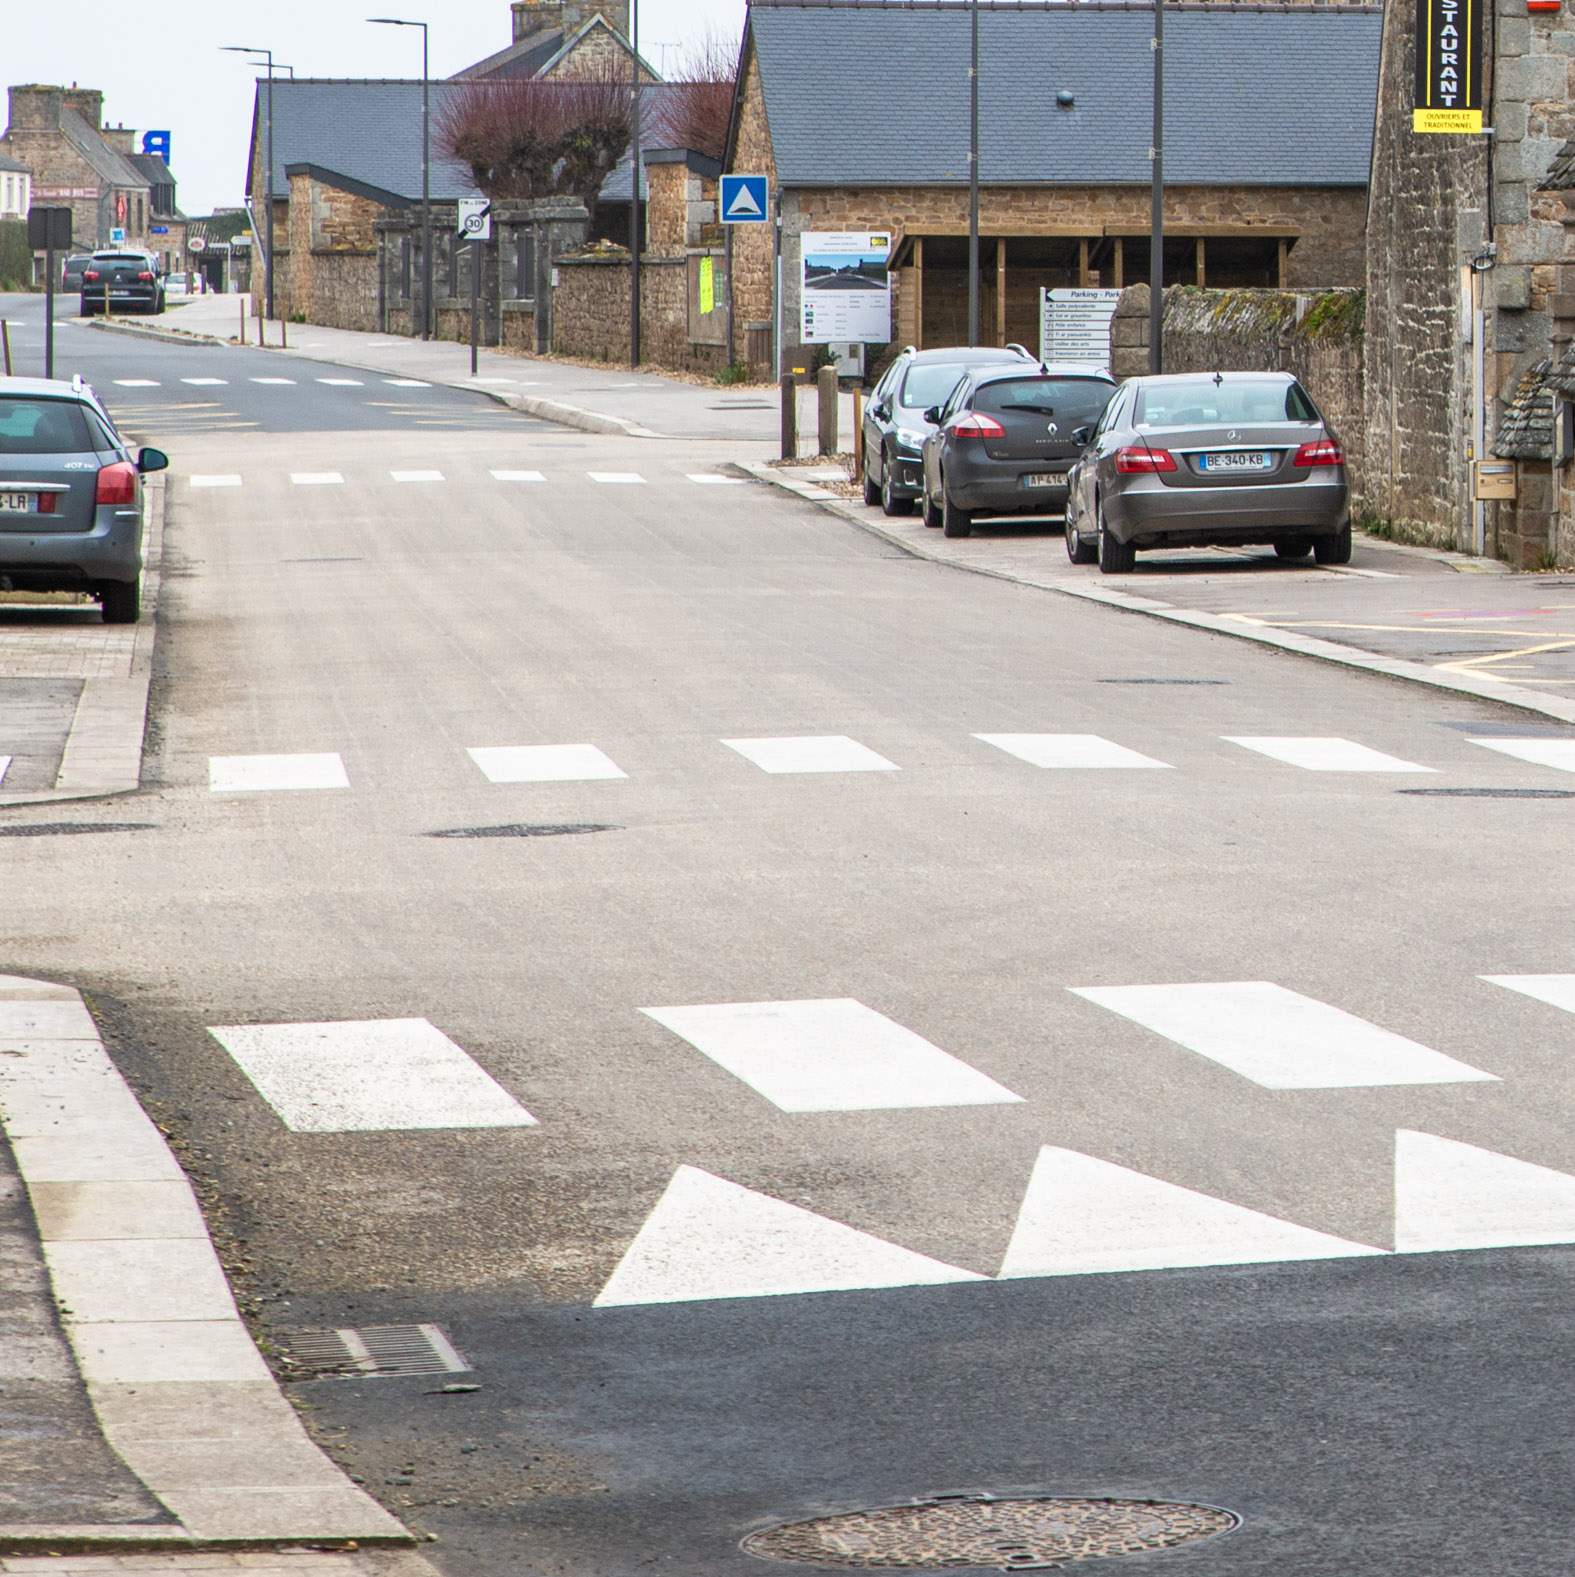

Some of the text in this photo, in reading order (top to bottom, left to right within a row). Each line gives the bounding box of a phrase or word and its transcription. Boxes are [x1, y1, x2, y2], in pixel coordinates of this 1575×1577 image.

[468, 219, 480, 228] 30
[1070, 291, 1098, 299] Parking
[1207, 454, 1263, 466] BE-340-KB
